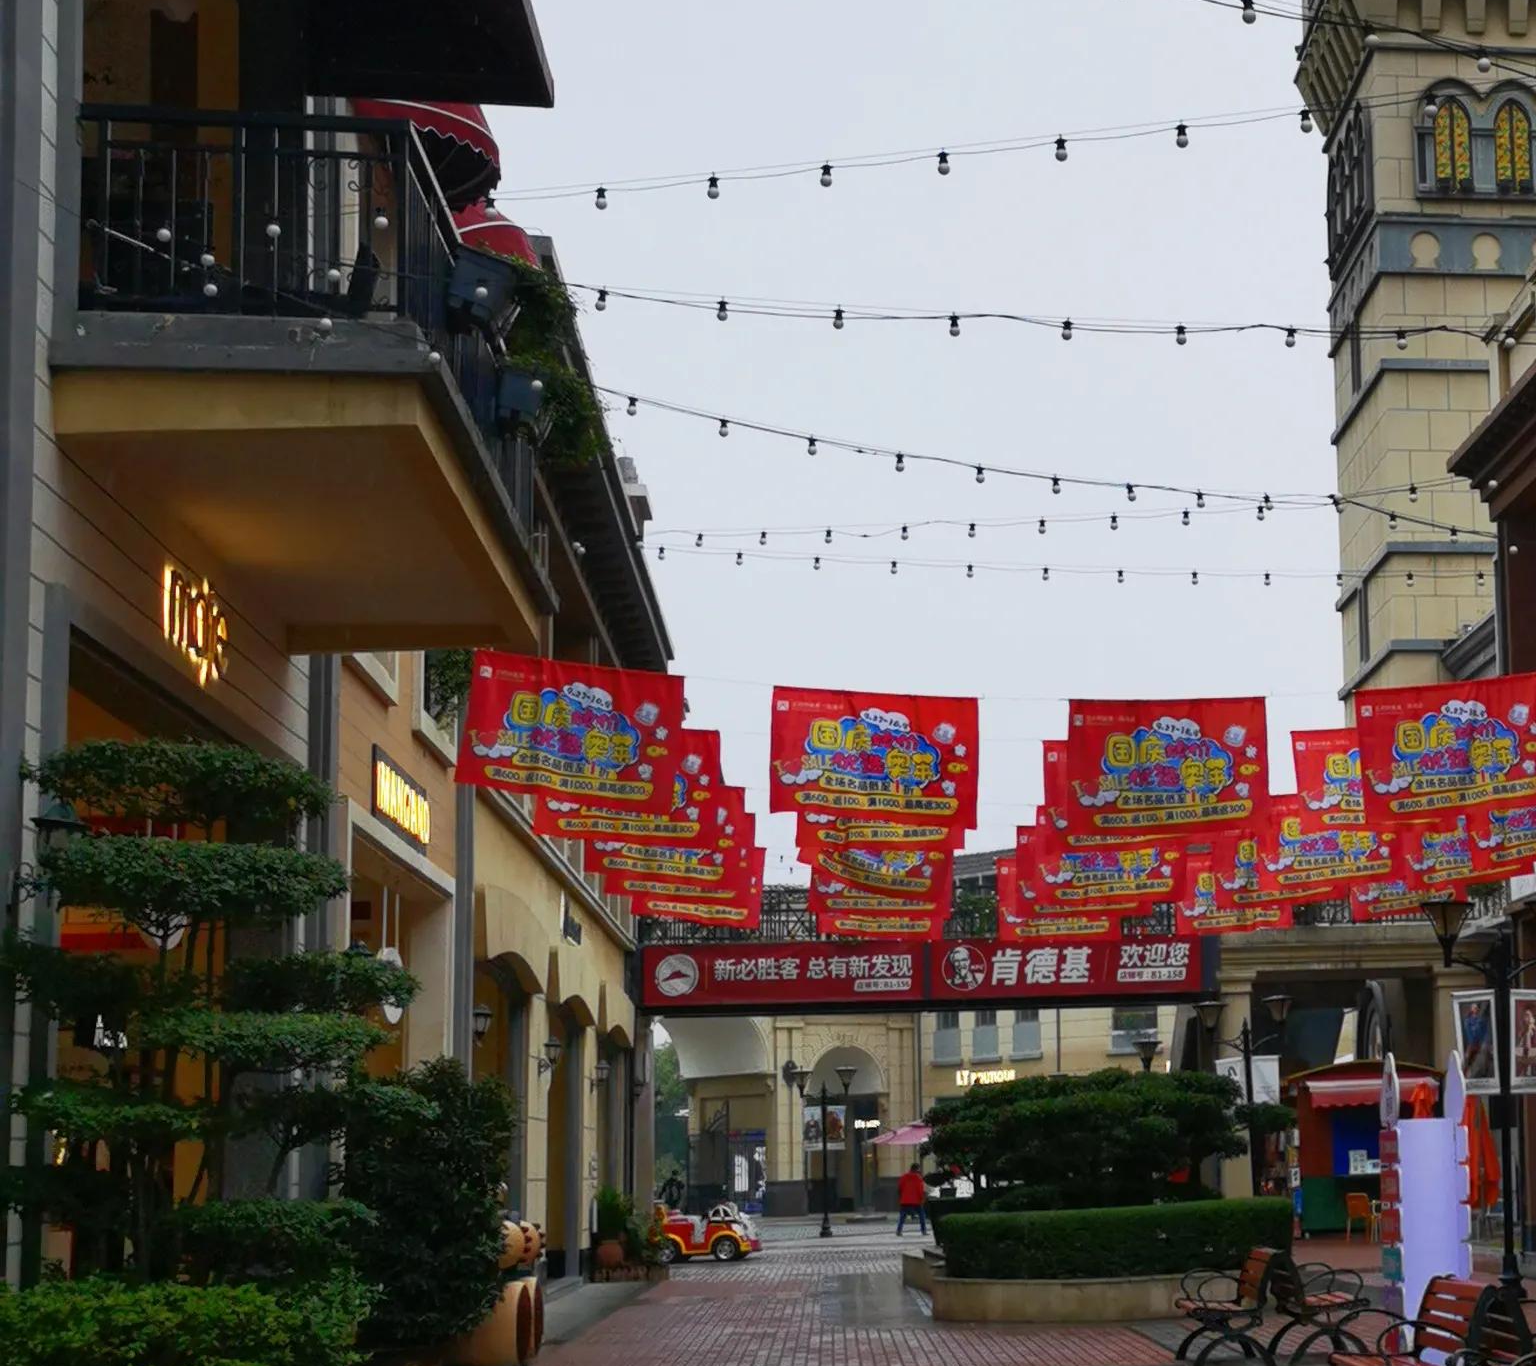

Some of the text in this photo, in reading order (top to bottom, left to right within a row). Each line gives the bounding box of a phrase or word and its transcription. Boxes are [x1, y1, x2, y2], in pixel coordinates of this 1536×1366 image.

[991, 946, 1092, 985] 肯德基
[1119, 942, 1191, 967] 欢迎您
[713, 955, 912, 982] 新必胜客 总有新发现
